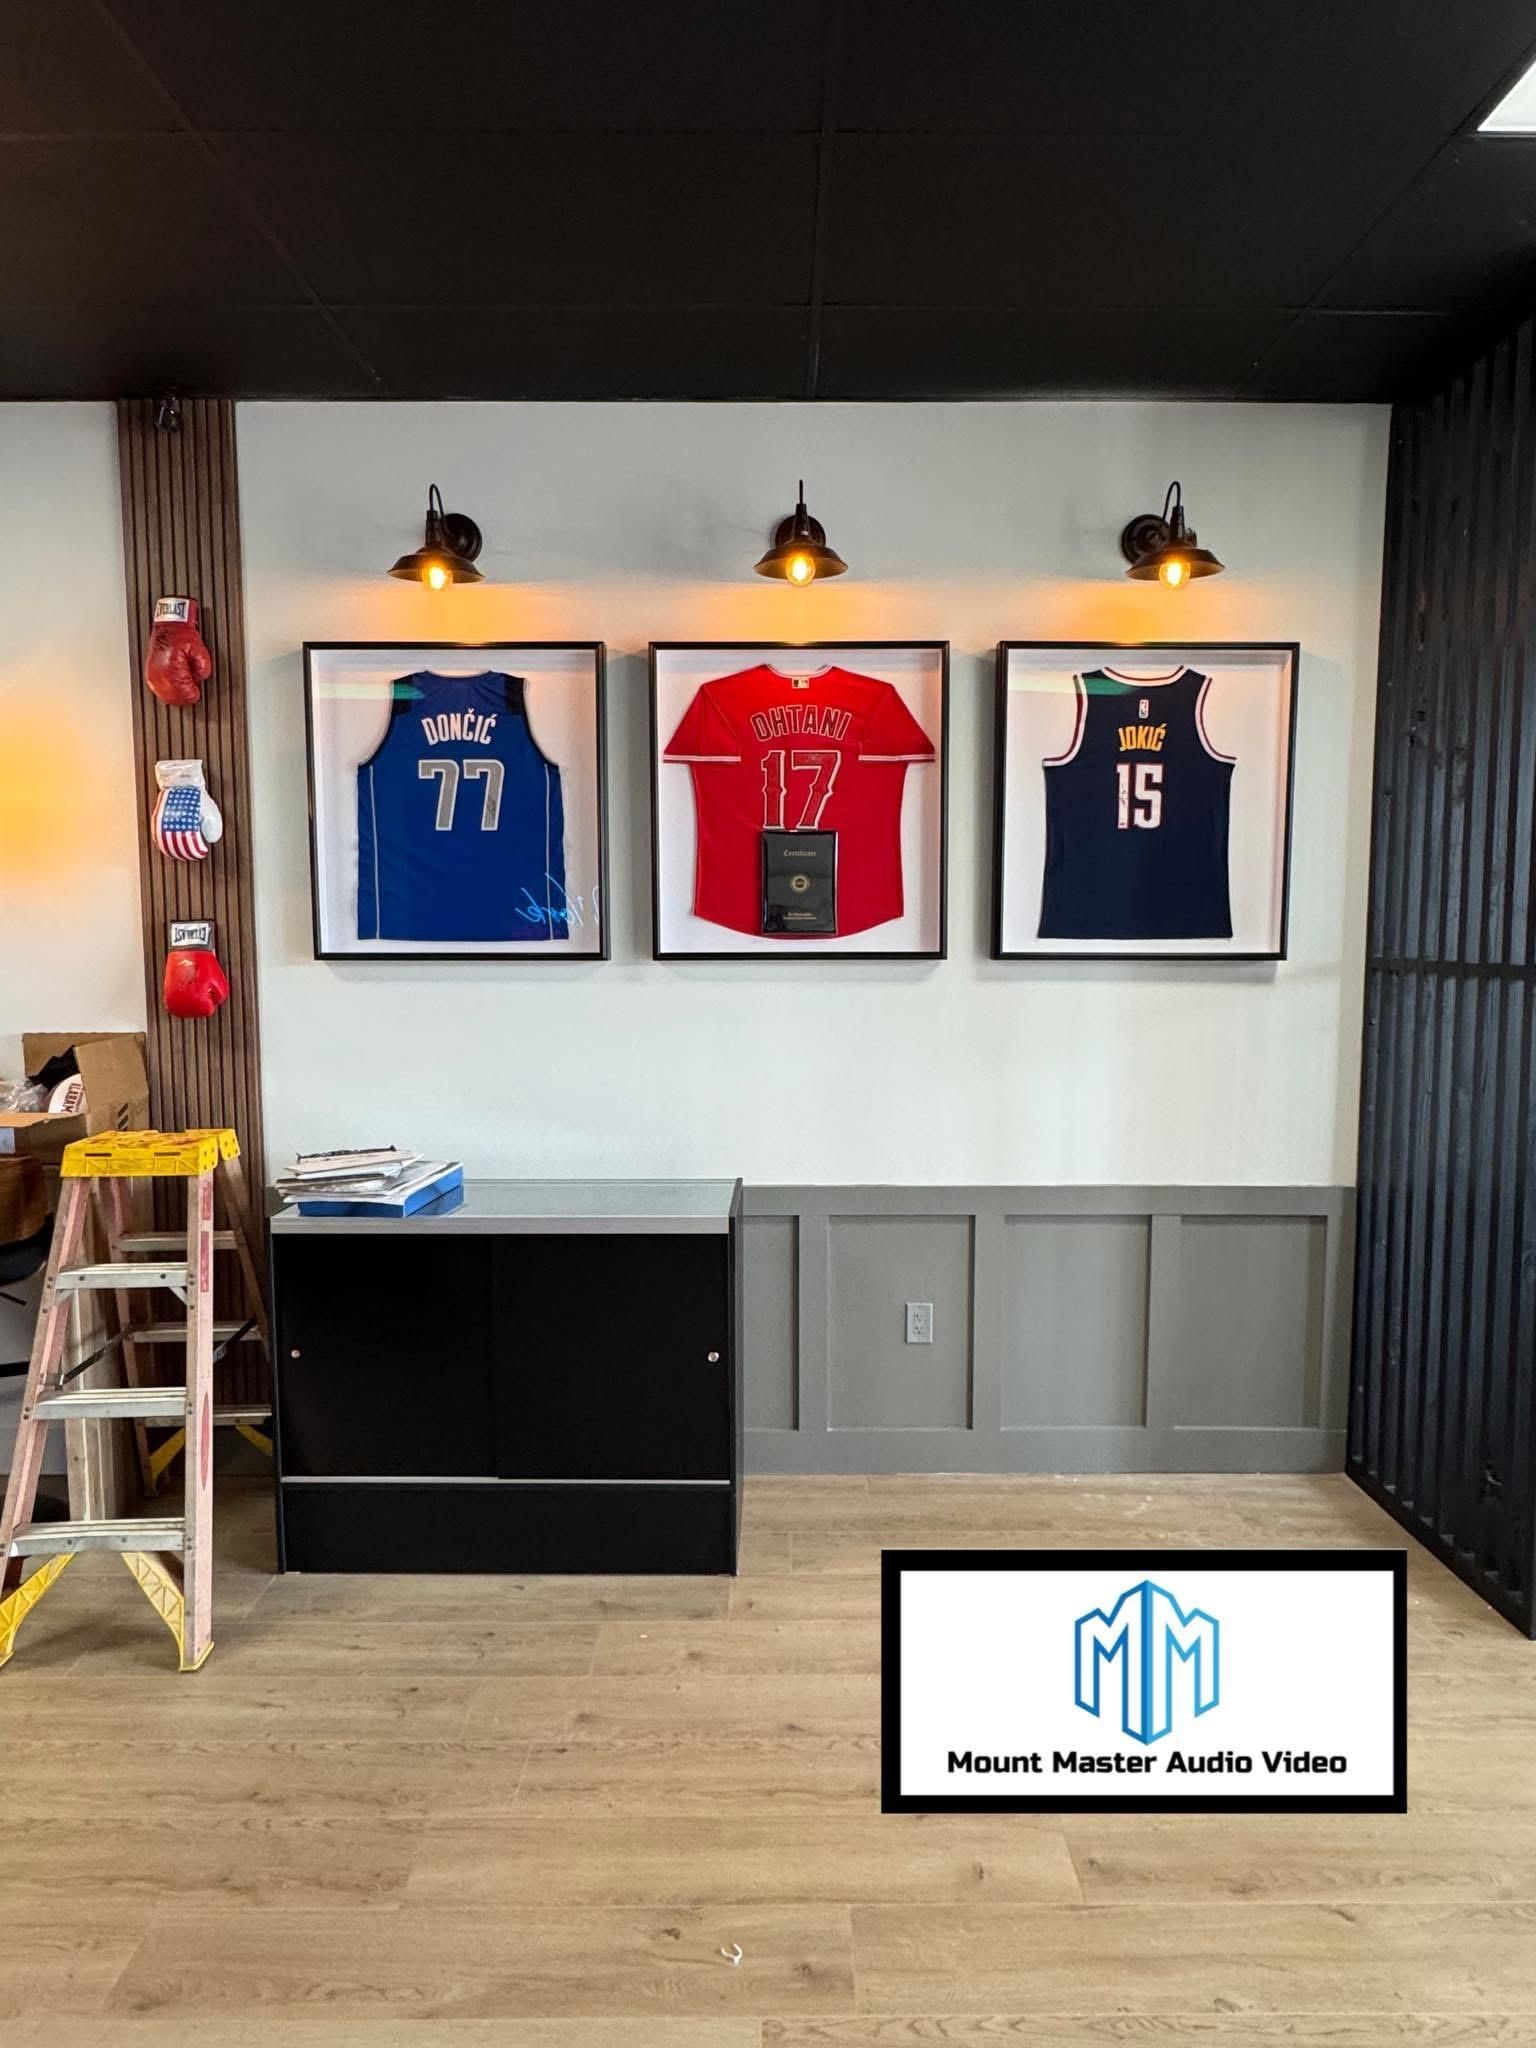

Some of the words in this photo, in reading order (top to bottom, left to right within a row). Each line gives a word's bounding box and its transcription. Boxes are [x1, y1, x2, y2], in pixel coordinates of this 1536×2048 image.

[421, 707, 498, 746] DONČIĆ
[750, 704, 853, 742] OHTANI
[1118, 723, 1167, 752] JOKIĆ
[418, 759, 505, 831] 77
[760, 749, 842, 831] 17
[1116, 763, 1164, 830] 15
